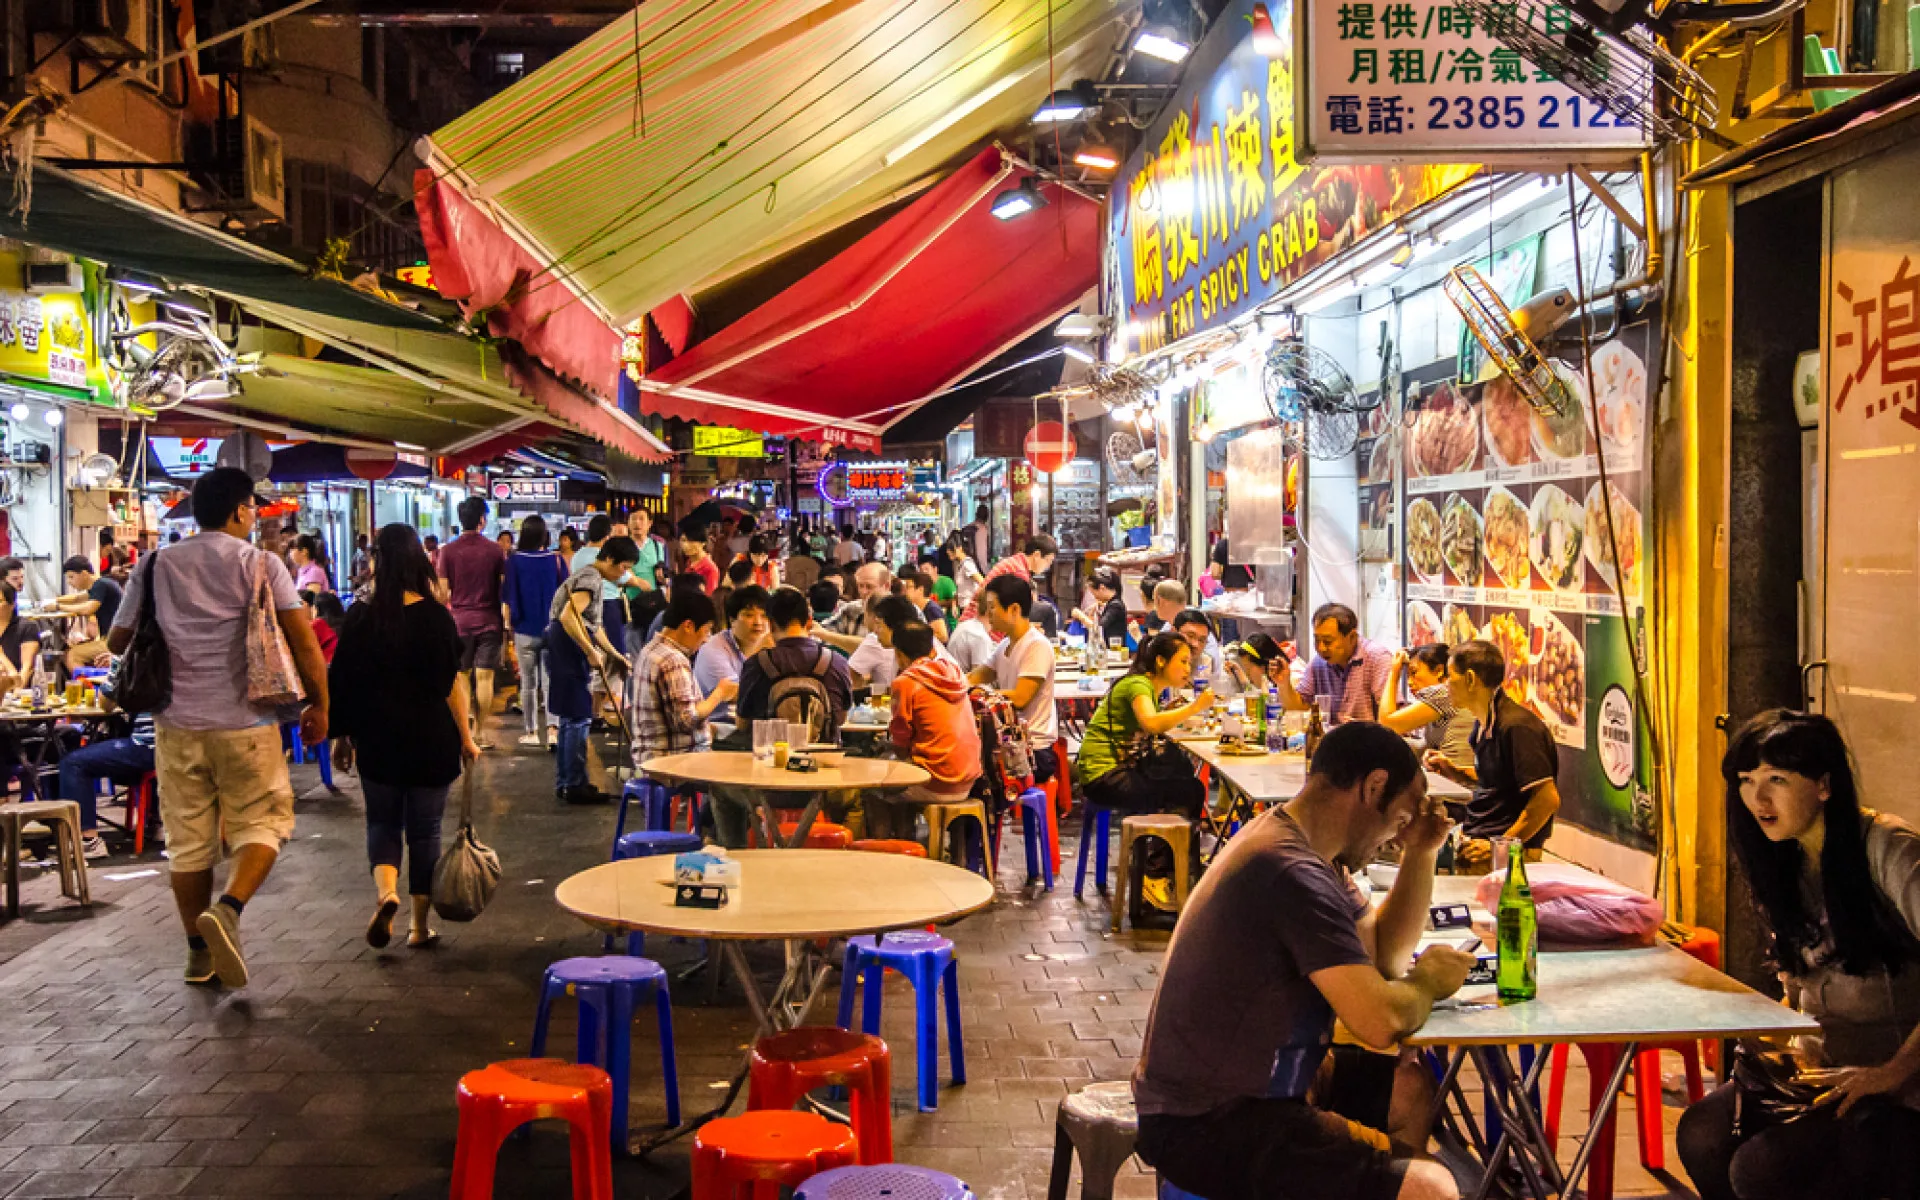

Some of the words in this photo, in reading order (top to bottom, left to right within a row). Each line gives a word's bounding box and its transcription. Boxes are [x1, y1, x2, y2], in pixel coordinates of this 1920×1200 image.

[1326, 95, 1415, 134] 電話:
[1428, 95, 1525, 129] 2385
[1171, 289, 1195, 339] FAT
[1199, 247, 1249, 321] SPICY
[1257, 197, 1320, 283] CRAB
